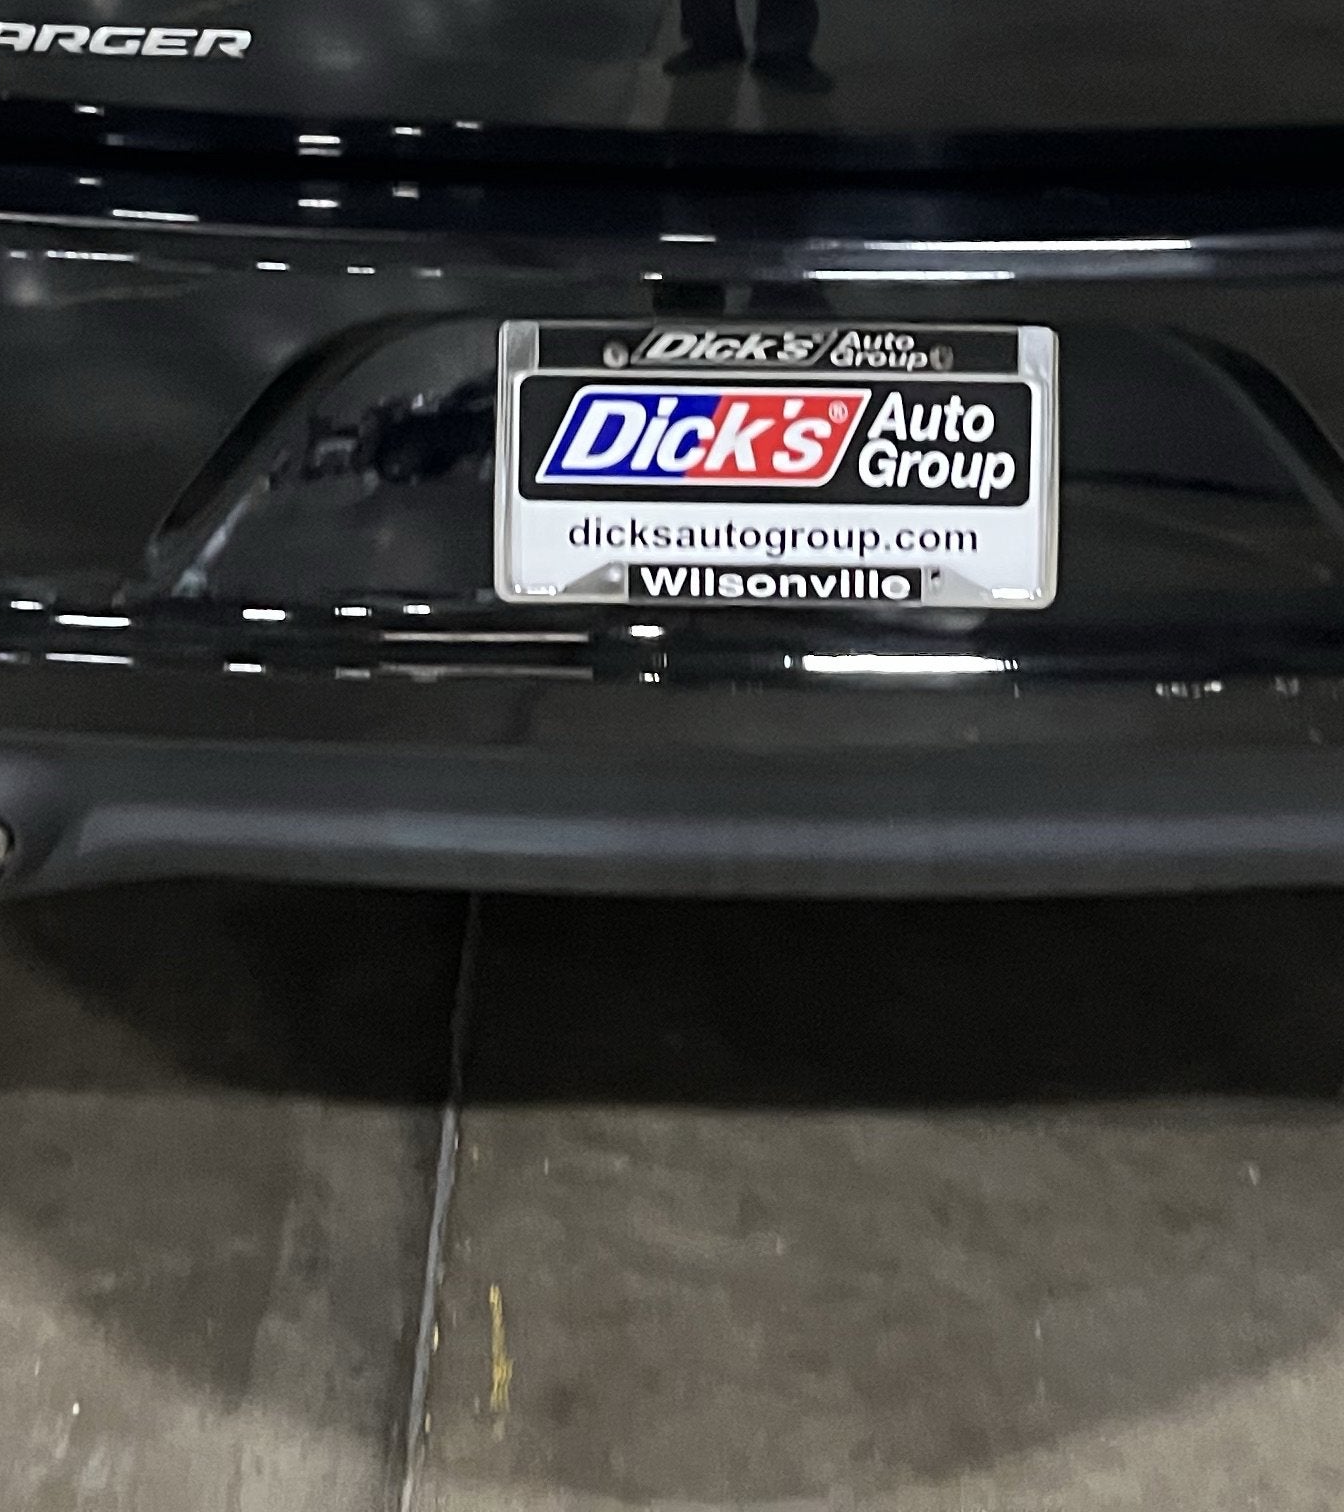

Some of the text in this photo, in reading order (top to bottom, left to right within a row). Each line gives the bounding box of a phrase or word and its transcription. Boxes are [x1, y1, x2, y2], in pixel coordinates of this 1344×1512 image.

[837, 330, 916, 351] Auto
[829, 349, 929, 371] Group
[561, 391, 996, 473] Dick's Auto
[856, 439, 1017, 499] Group
[567, 516, 980, 558] dicksautogroup.com
[639, 566, 912, 600] Wilsonville
